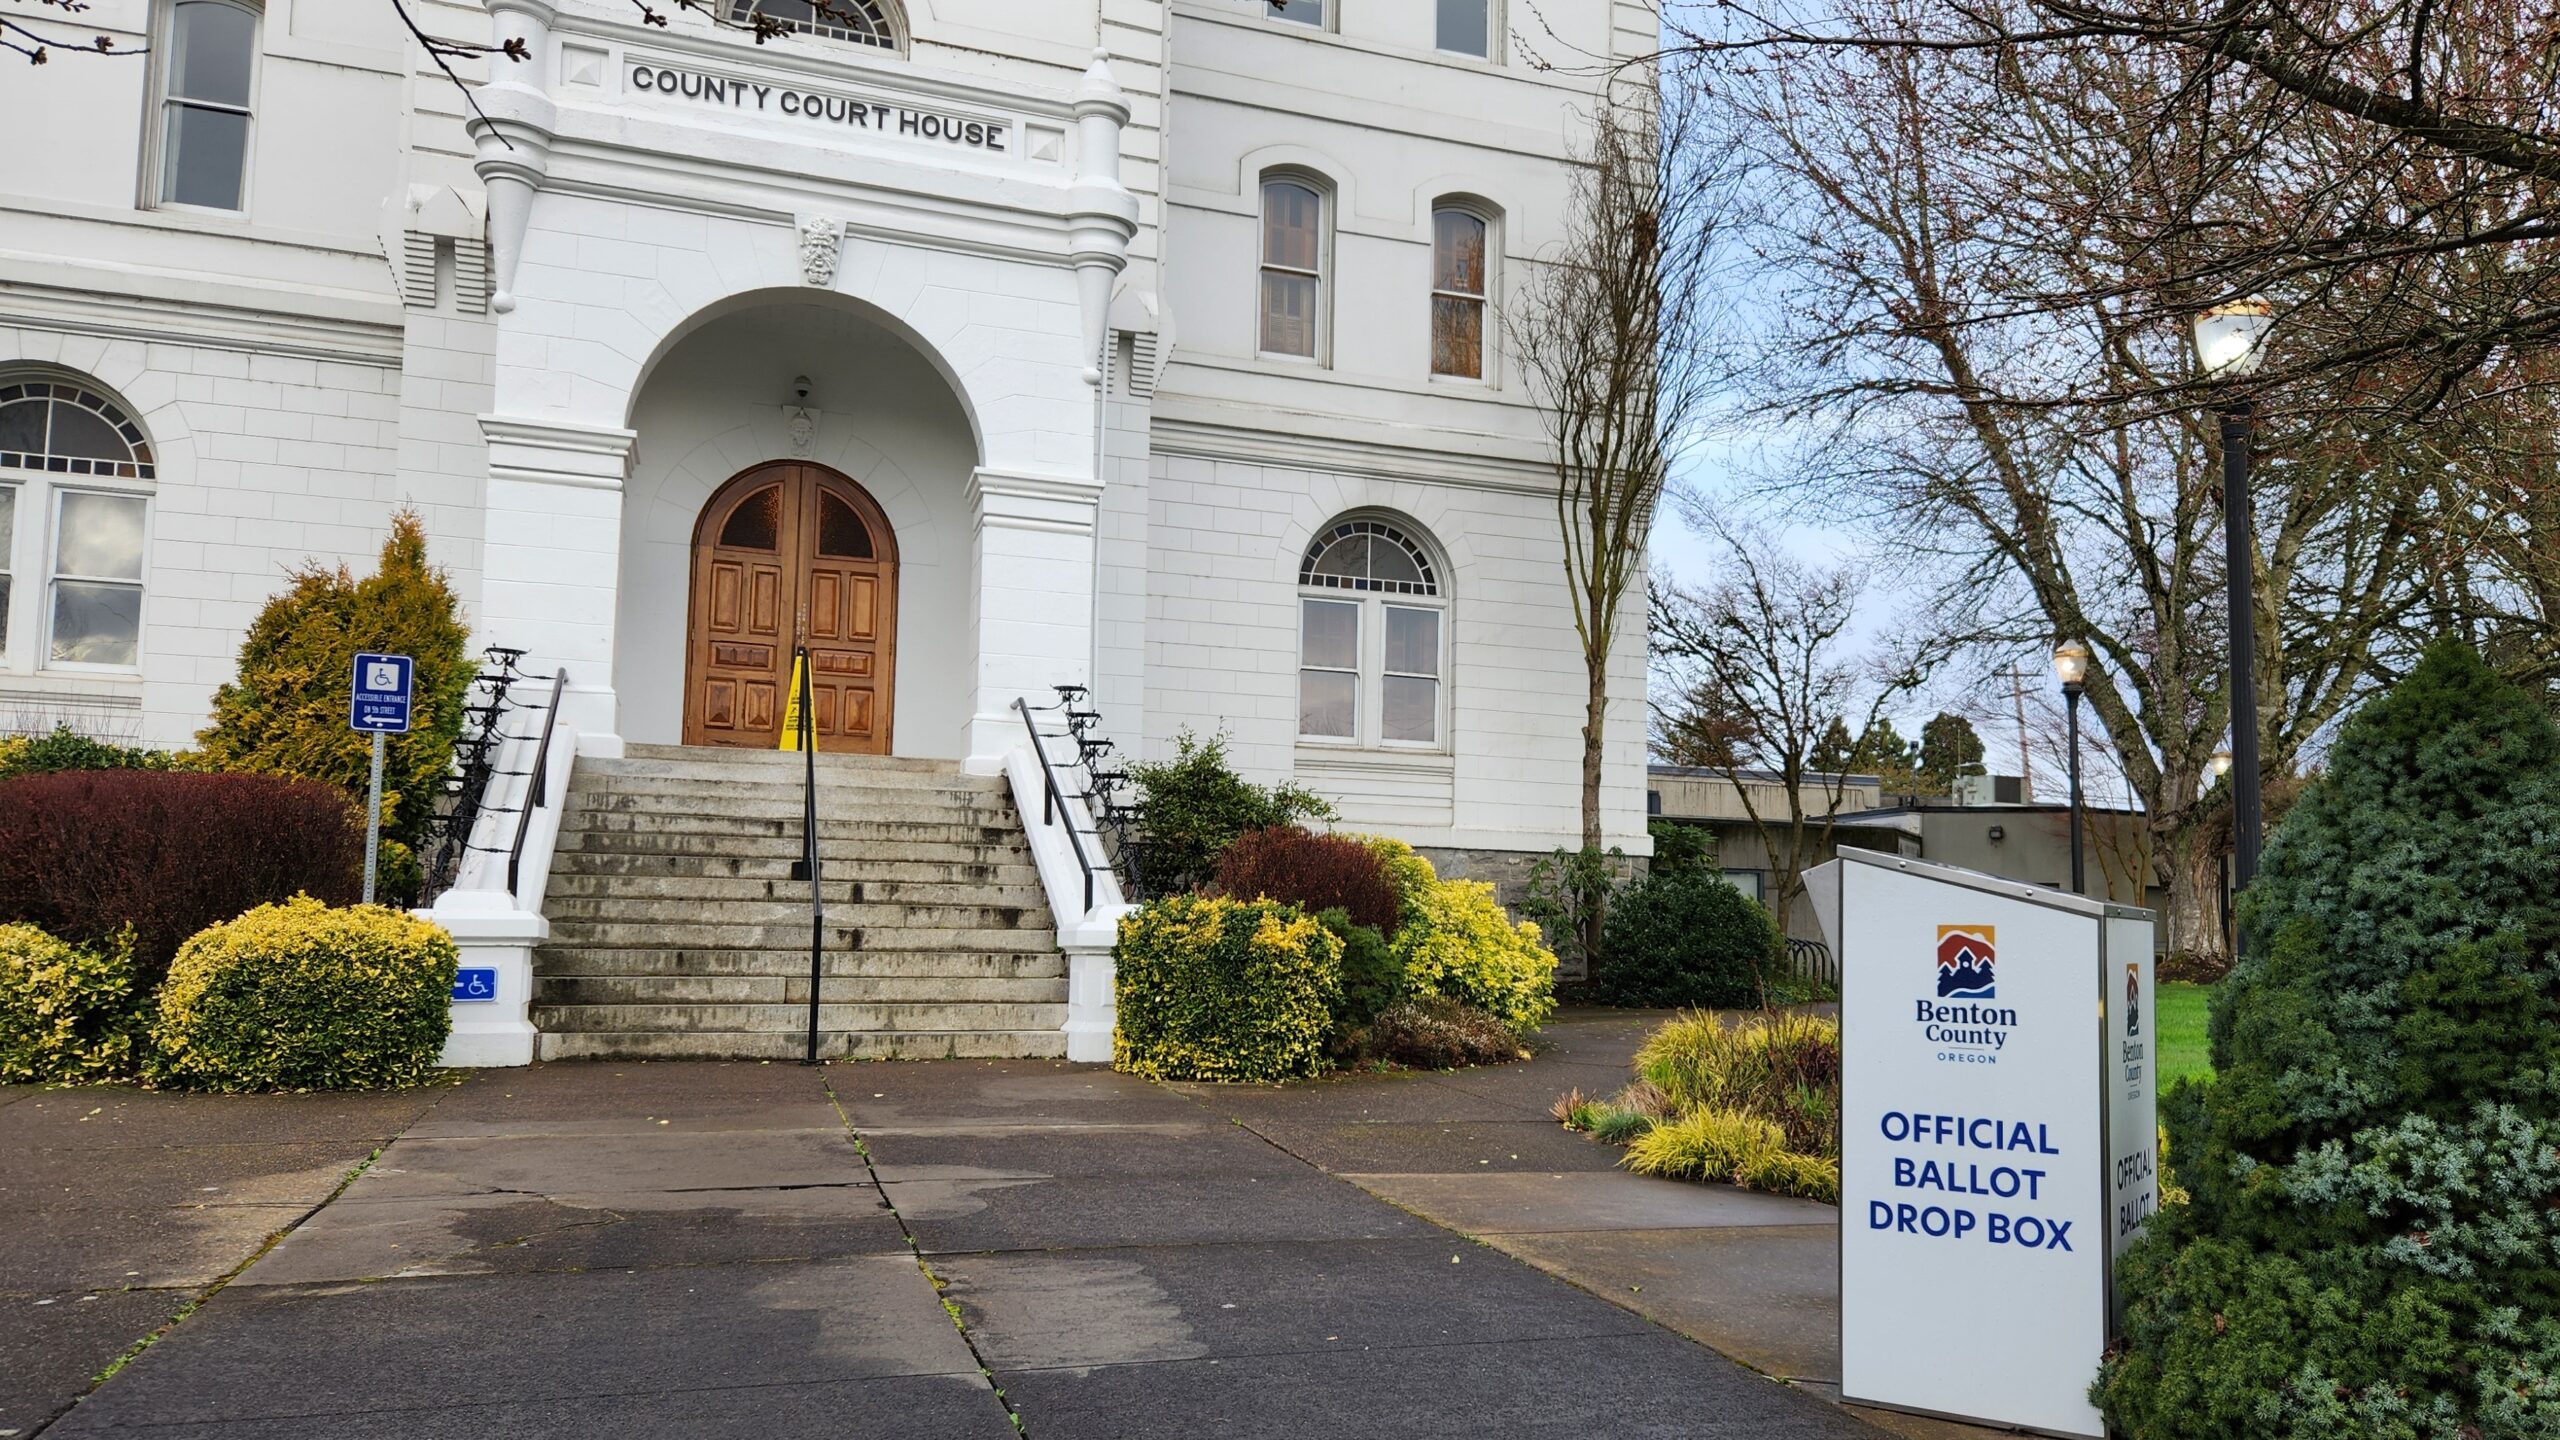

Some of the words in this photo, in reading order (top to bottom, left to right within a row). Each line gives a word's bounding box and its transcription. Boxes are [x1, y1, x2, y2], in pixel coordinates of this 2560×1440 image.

[633, 66, 770, 109] COUNTY
[780, 91, 890, 129] COURT
[900, 111, 1005, 151] HOUSE
[356, 693, 382, 702] ACCESSIBLE
[384, 694, 406, 704] ENTRANCE
[364, 705, 370, 714] ON
[380, 706, 396, 715] STREET
[1916, 1000, 2017, 1026] Benton
[1925, 1024, 2007, 1050] County
[2122, 1040, 2143, 1063] Benton
[1937, 1052, 1996, 1064] OREGON
[1881, 1111, 2059, 1155] OFFICIAL
[1894, 1157, 2046, 1200] BALLOT
[2117, 1147, 2152, 1190] OFFICIAL
[1869, 1200, 1976, 1239] DROP
[1988, 1213, 2073, 1252] BOX
[2121, 1192, 2150, 1236] BALLOT
